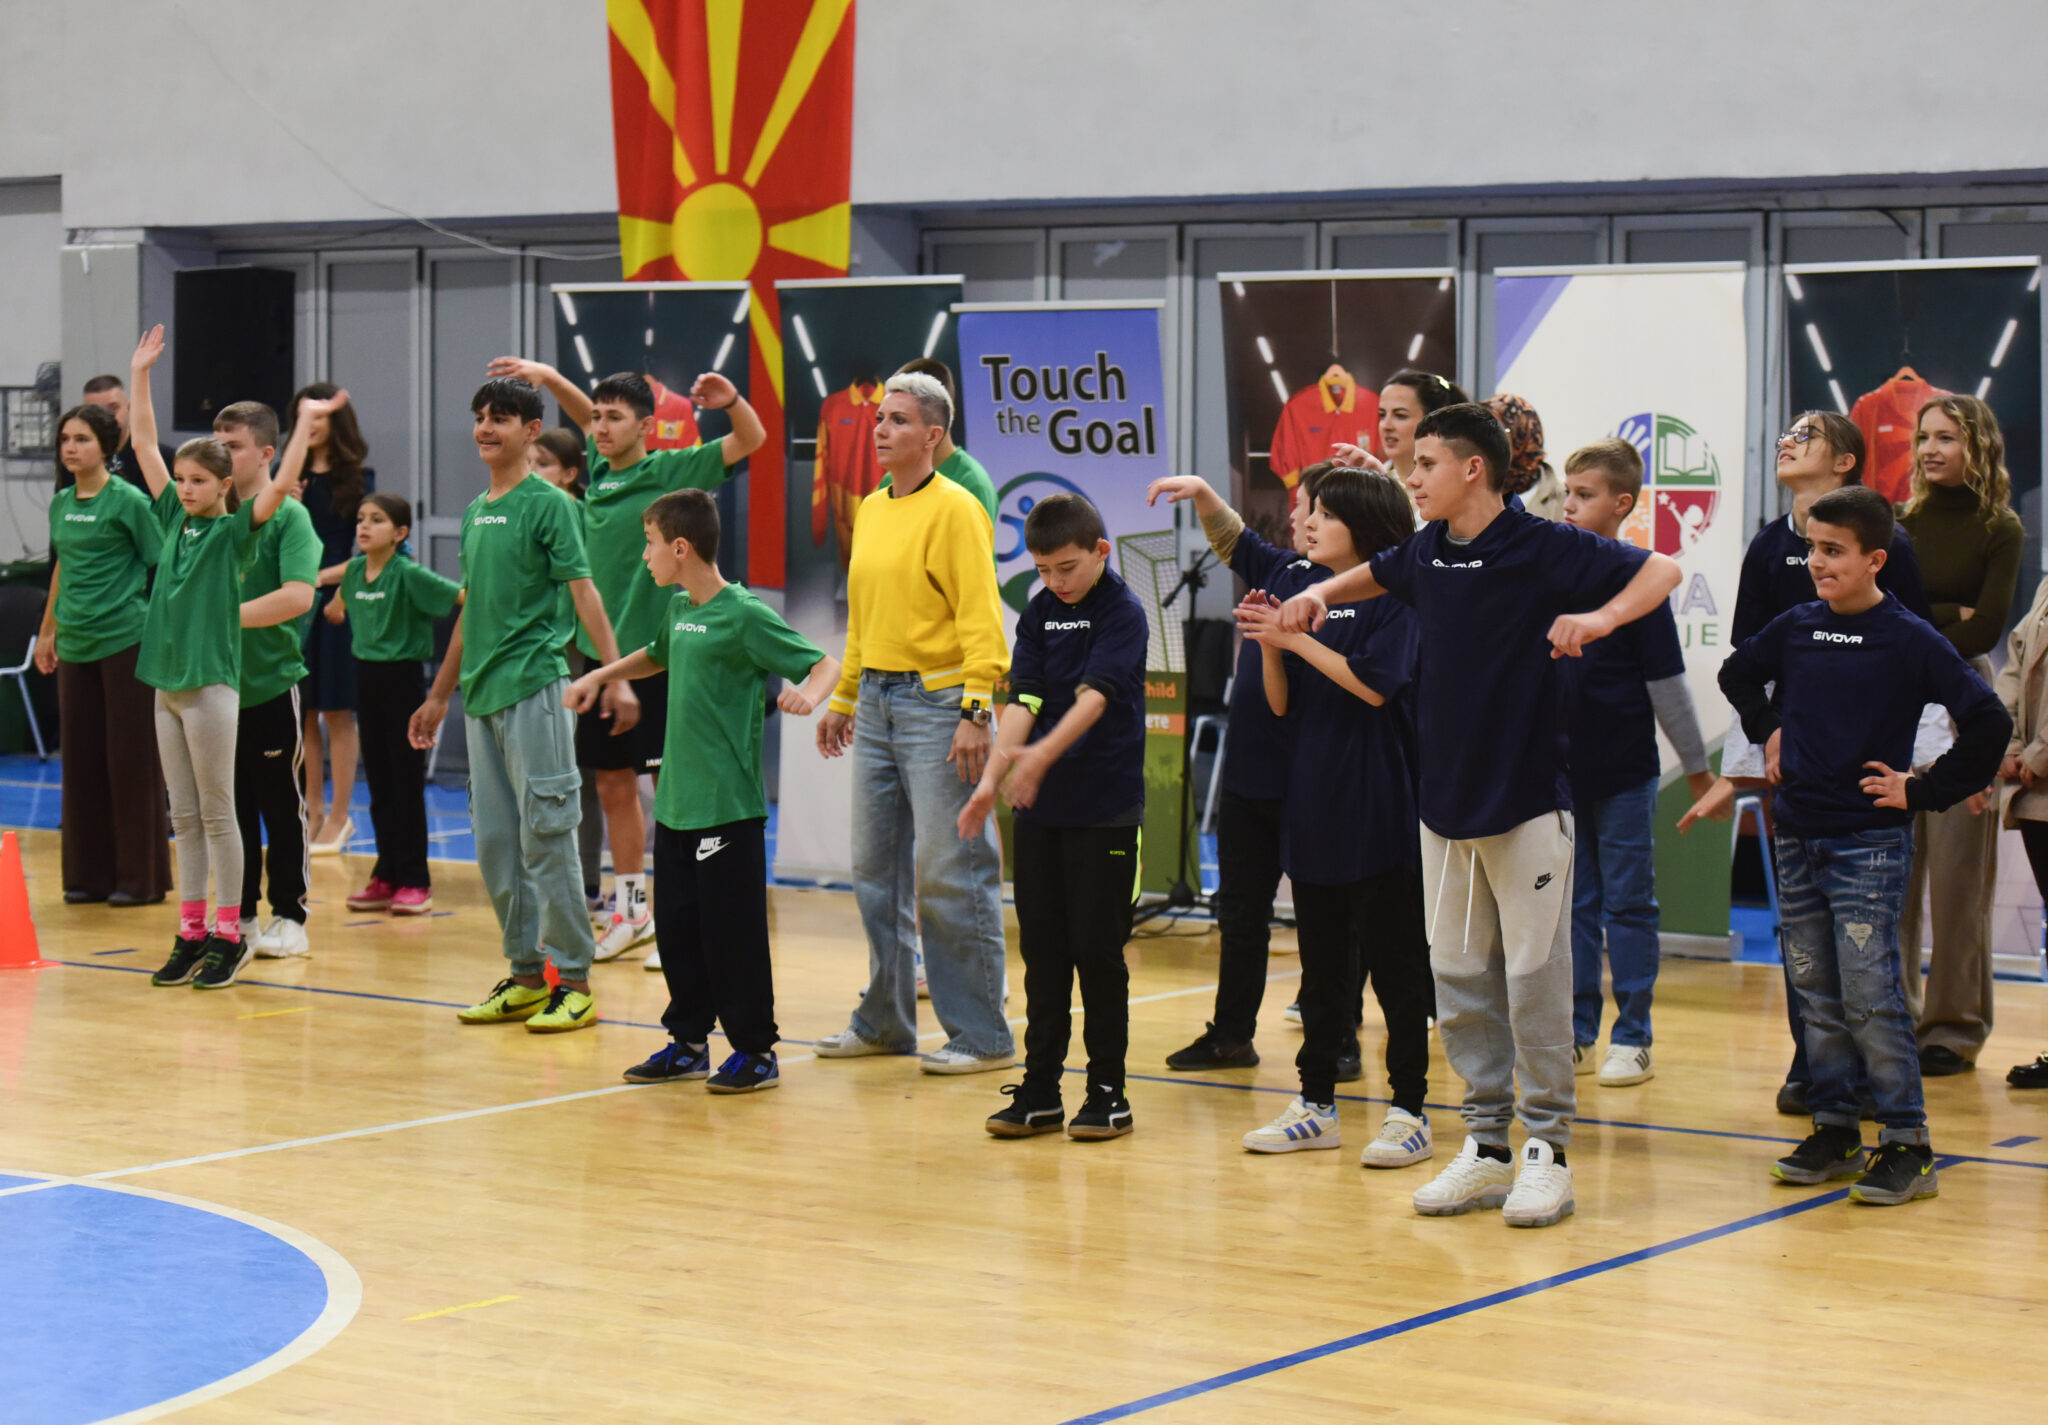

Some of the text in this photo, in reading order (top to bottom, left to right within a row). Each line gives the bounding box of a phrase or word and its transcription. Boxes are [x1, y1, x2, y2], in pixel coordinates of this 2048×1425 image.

[980, 351, 1128, 403] Touch
[996, 405, 1156, 456] the Goal
[474, 515, 508, 526] GIVOVA
[1786, 556, 1810, 566] GIV
[674, 622, 708, 634] GIVOVA
[1044, 620, 1091, 631] GIVOVA
[1812, 630, 1863, 645] GIVOVA
[995, 677, 1177, 699] Fo hild
[700, 836, 722, 851] NIKE
